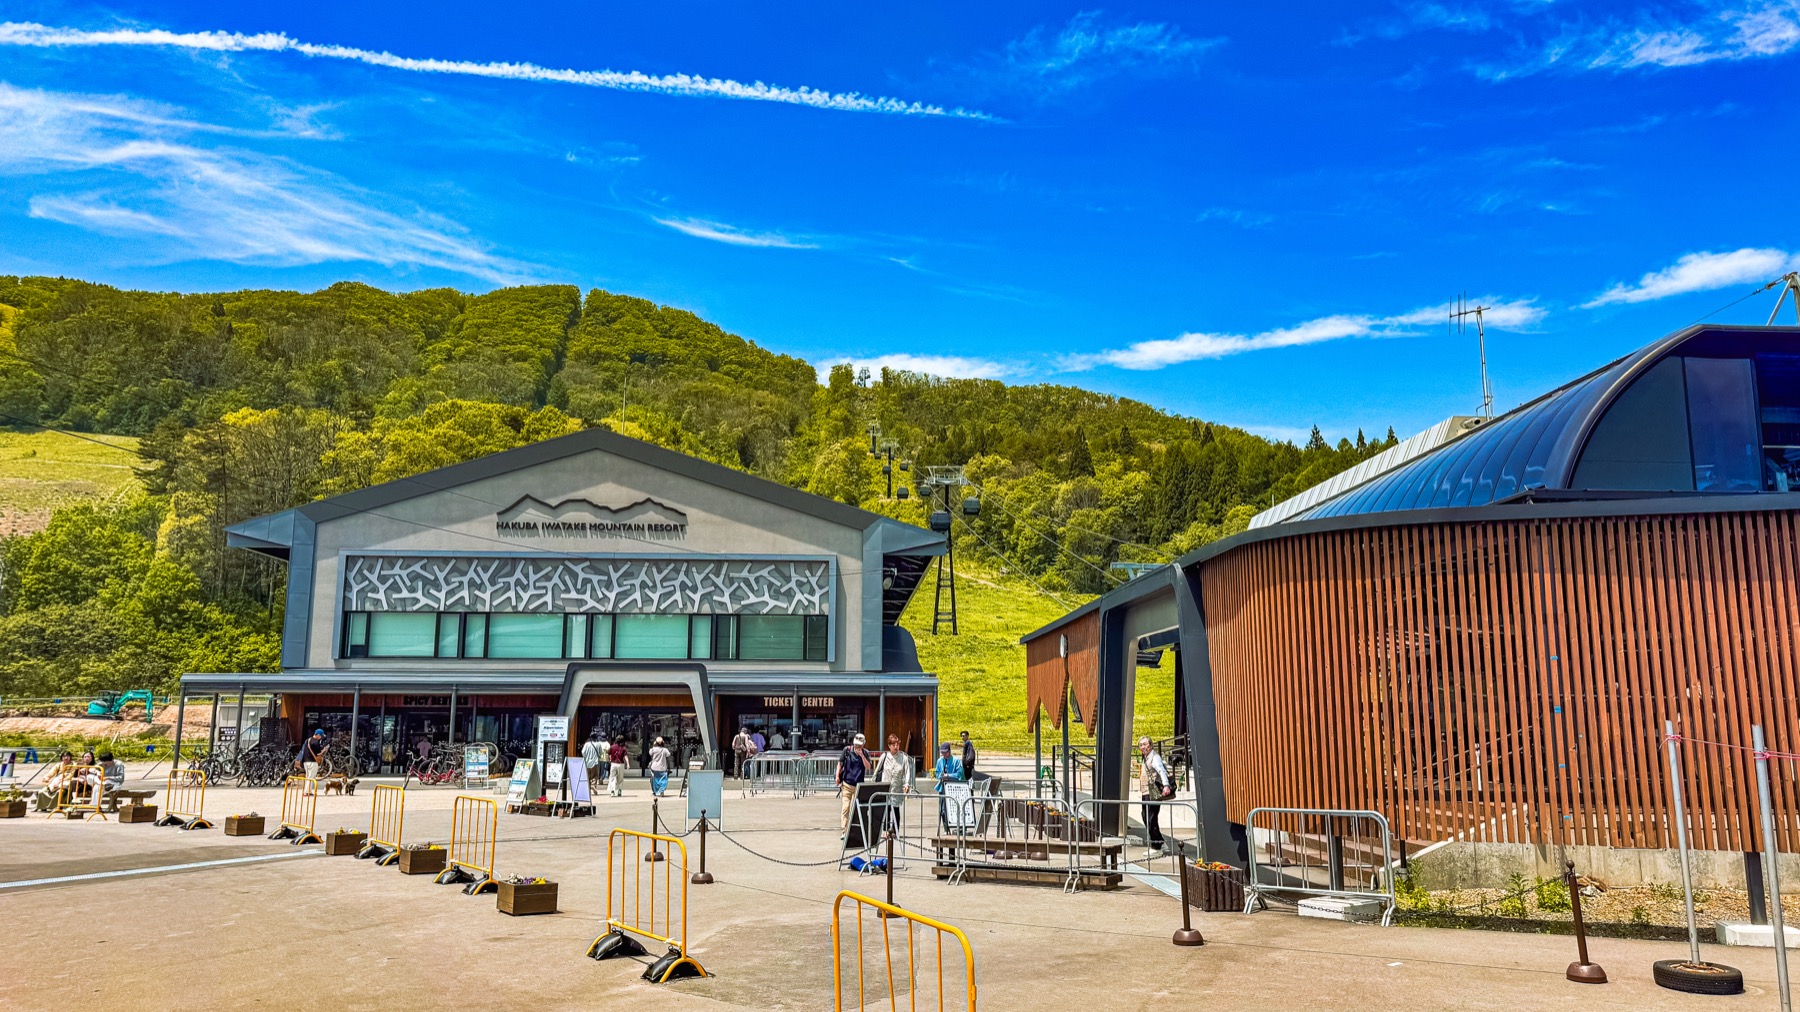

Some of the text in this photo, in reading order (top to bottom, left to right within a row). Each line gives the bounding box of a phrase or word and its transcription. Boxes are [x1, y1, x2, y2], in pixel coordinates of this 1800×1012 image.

[496, 521, 685, 532] HAKUBA IWATAKE MOUNTAIN RESORT
[404, 695, 431, 706] SPICY
[763, 696, 834, 707] TICKET CENTER
